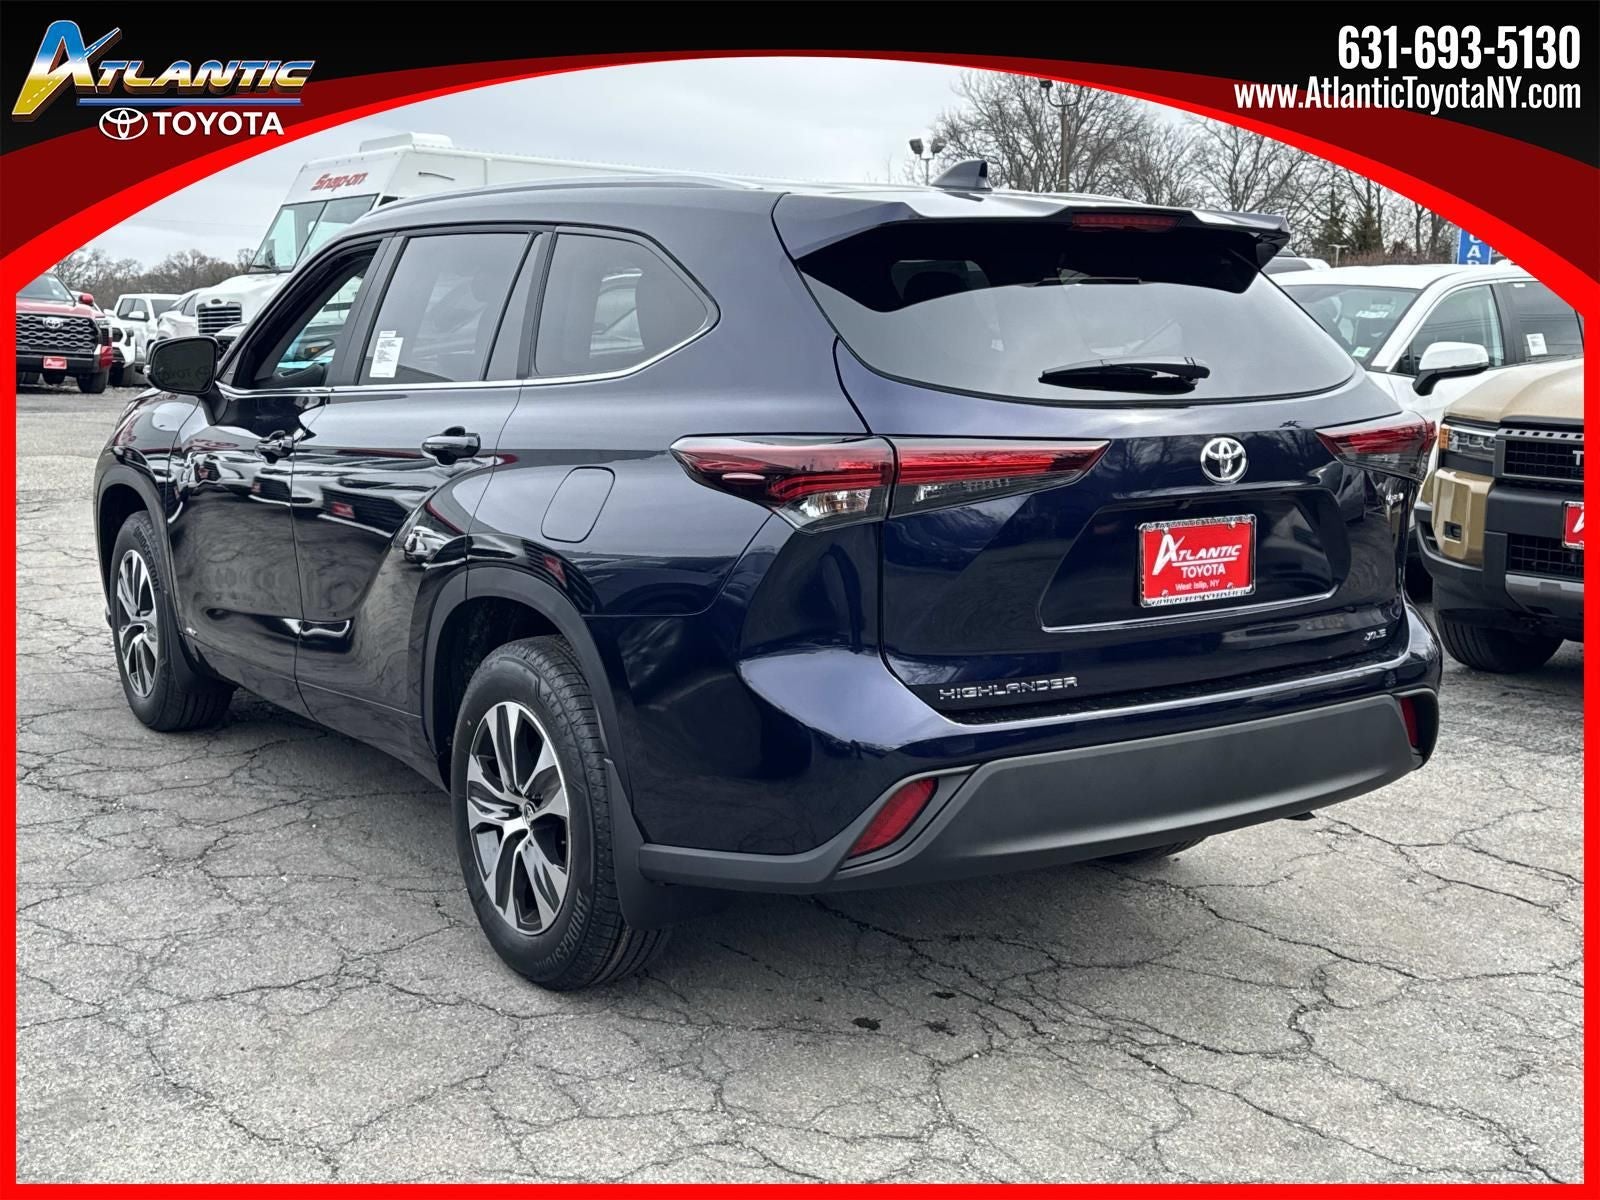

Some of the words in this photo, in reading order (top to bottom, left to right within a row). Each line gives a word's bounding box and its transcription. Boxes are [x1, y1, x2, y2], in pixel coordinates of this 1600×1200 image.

[310, 172, 369, 192] Snap-on
[1151, 534, 1242, 575] ATLANTIC
[1181, 563, 1226, 579] TOYOTA
[1174, 581, 1192, 592] West
[1210, 579, 1221, 589] NY
[938, 675, 1080, 701] HIGHLANDER
